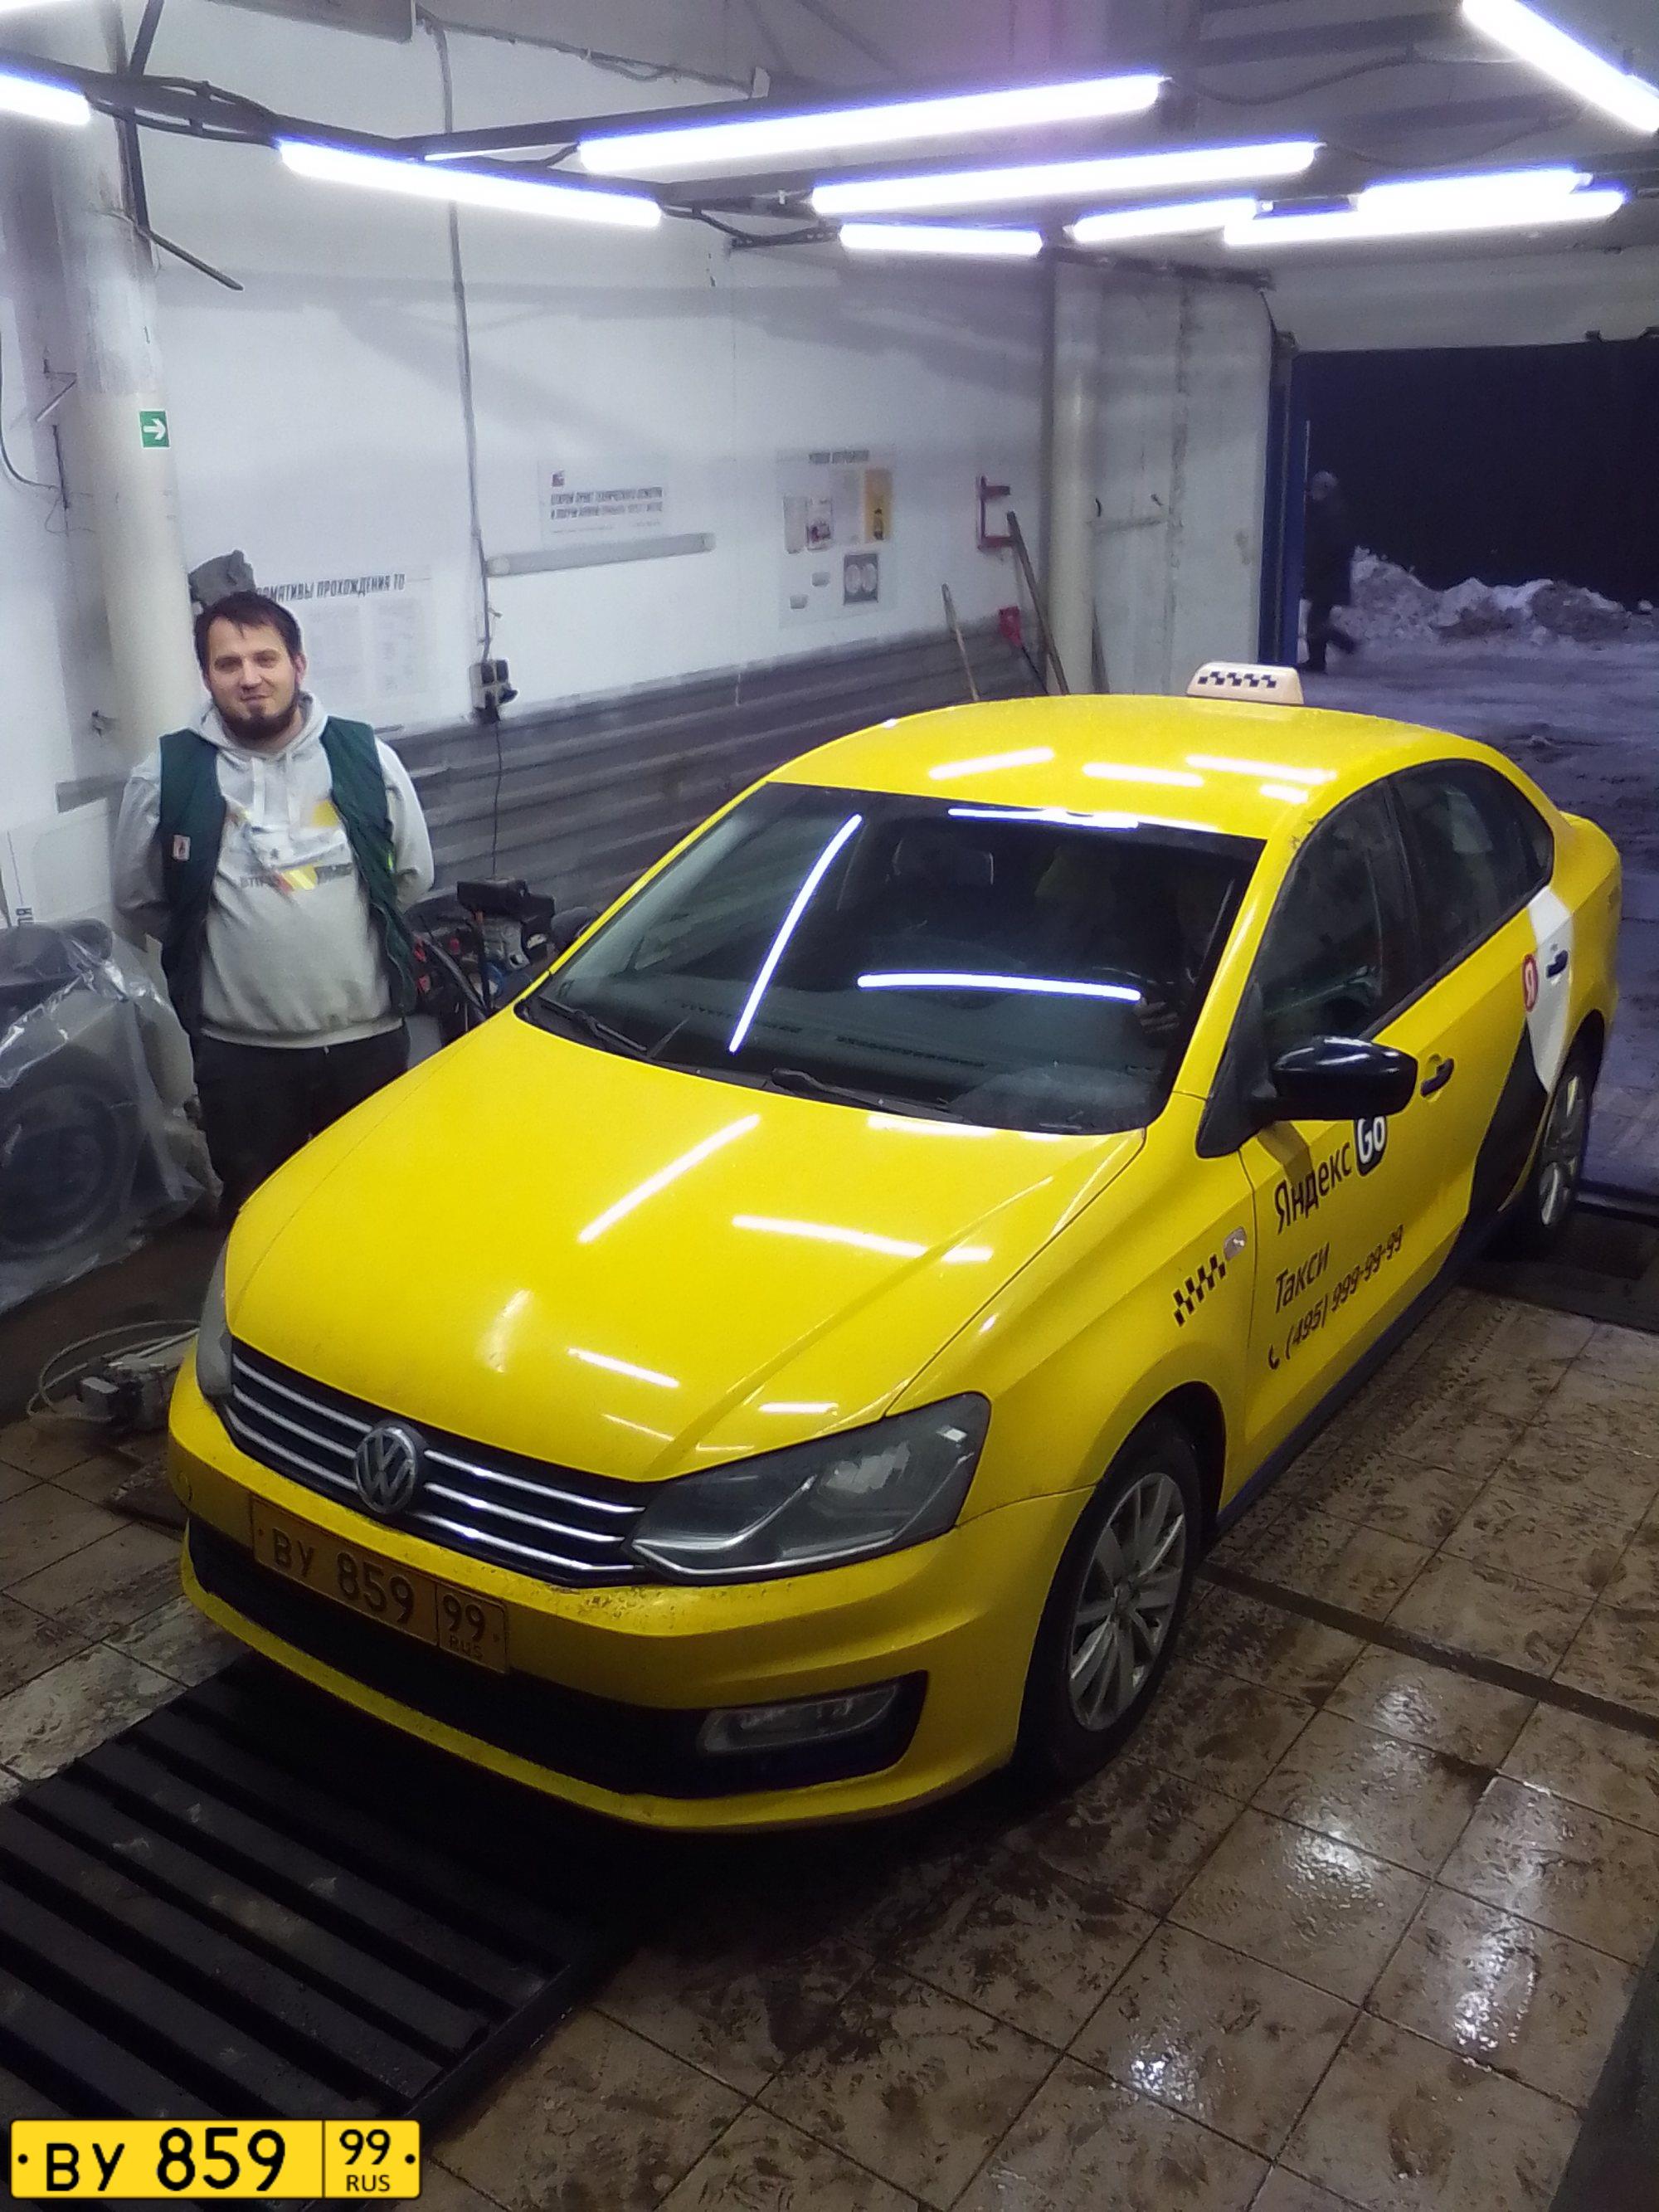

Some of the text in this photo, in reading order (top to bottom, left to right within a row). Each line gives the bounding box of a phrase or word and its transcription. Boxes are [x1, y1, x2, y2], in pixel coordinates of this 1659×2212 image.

[316, 575, 391, 598] ПРОХОЖДЕНИЯ
[393, 573, 406, 591] ТО
[1274, 1116, 1387, 1235] Яндекс Go
[1275, 1242, 1330, 1313] Такси
[1285, 1224, 1404, 1361] (495) 999-99-99
[337, 1551, 414, 1625] 859
[443, 1594, 485, 1642] 99
[450, 1634, 484, 1659] RUS
